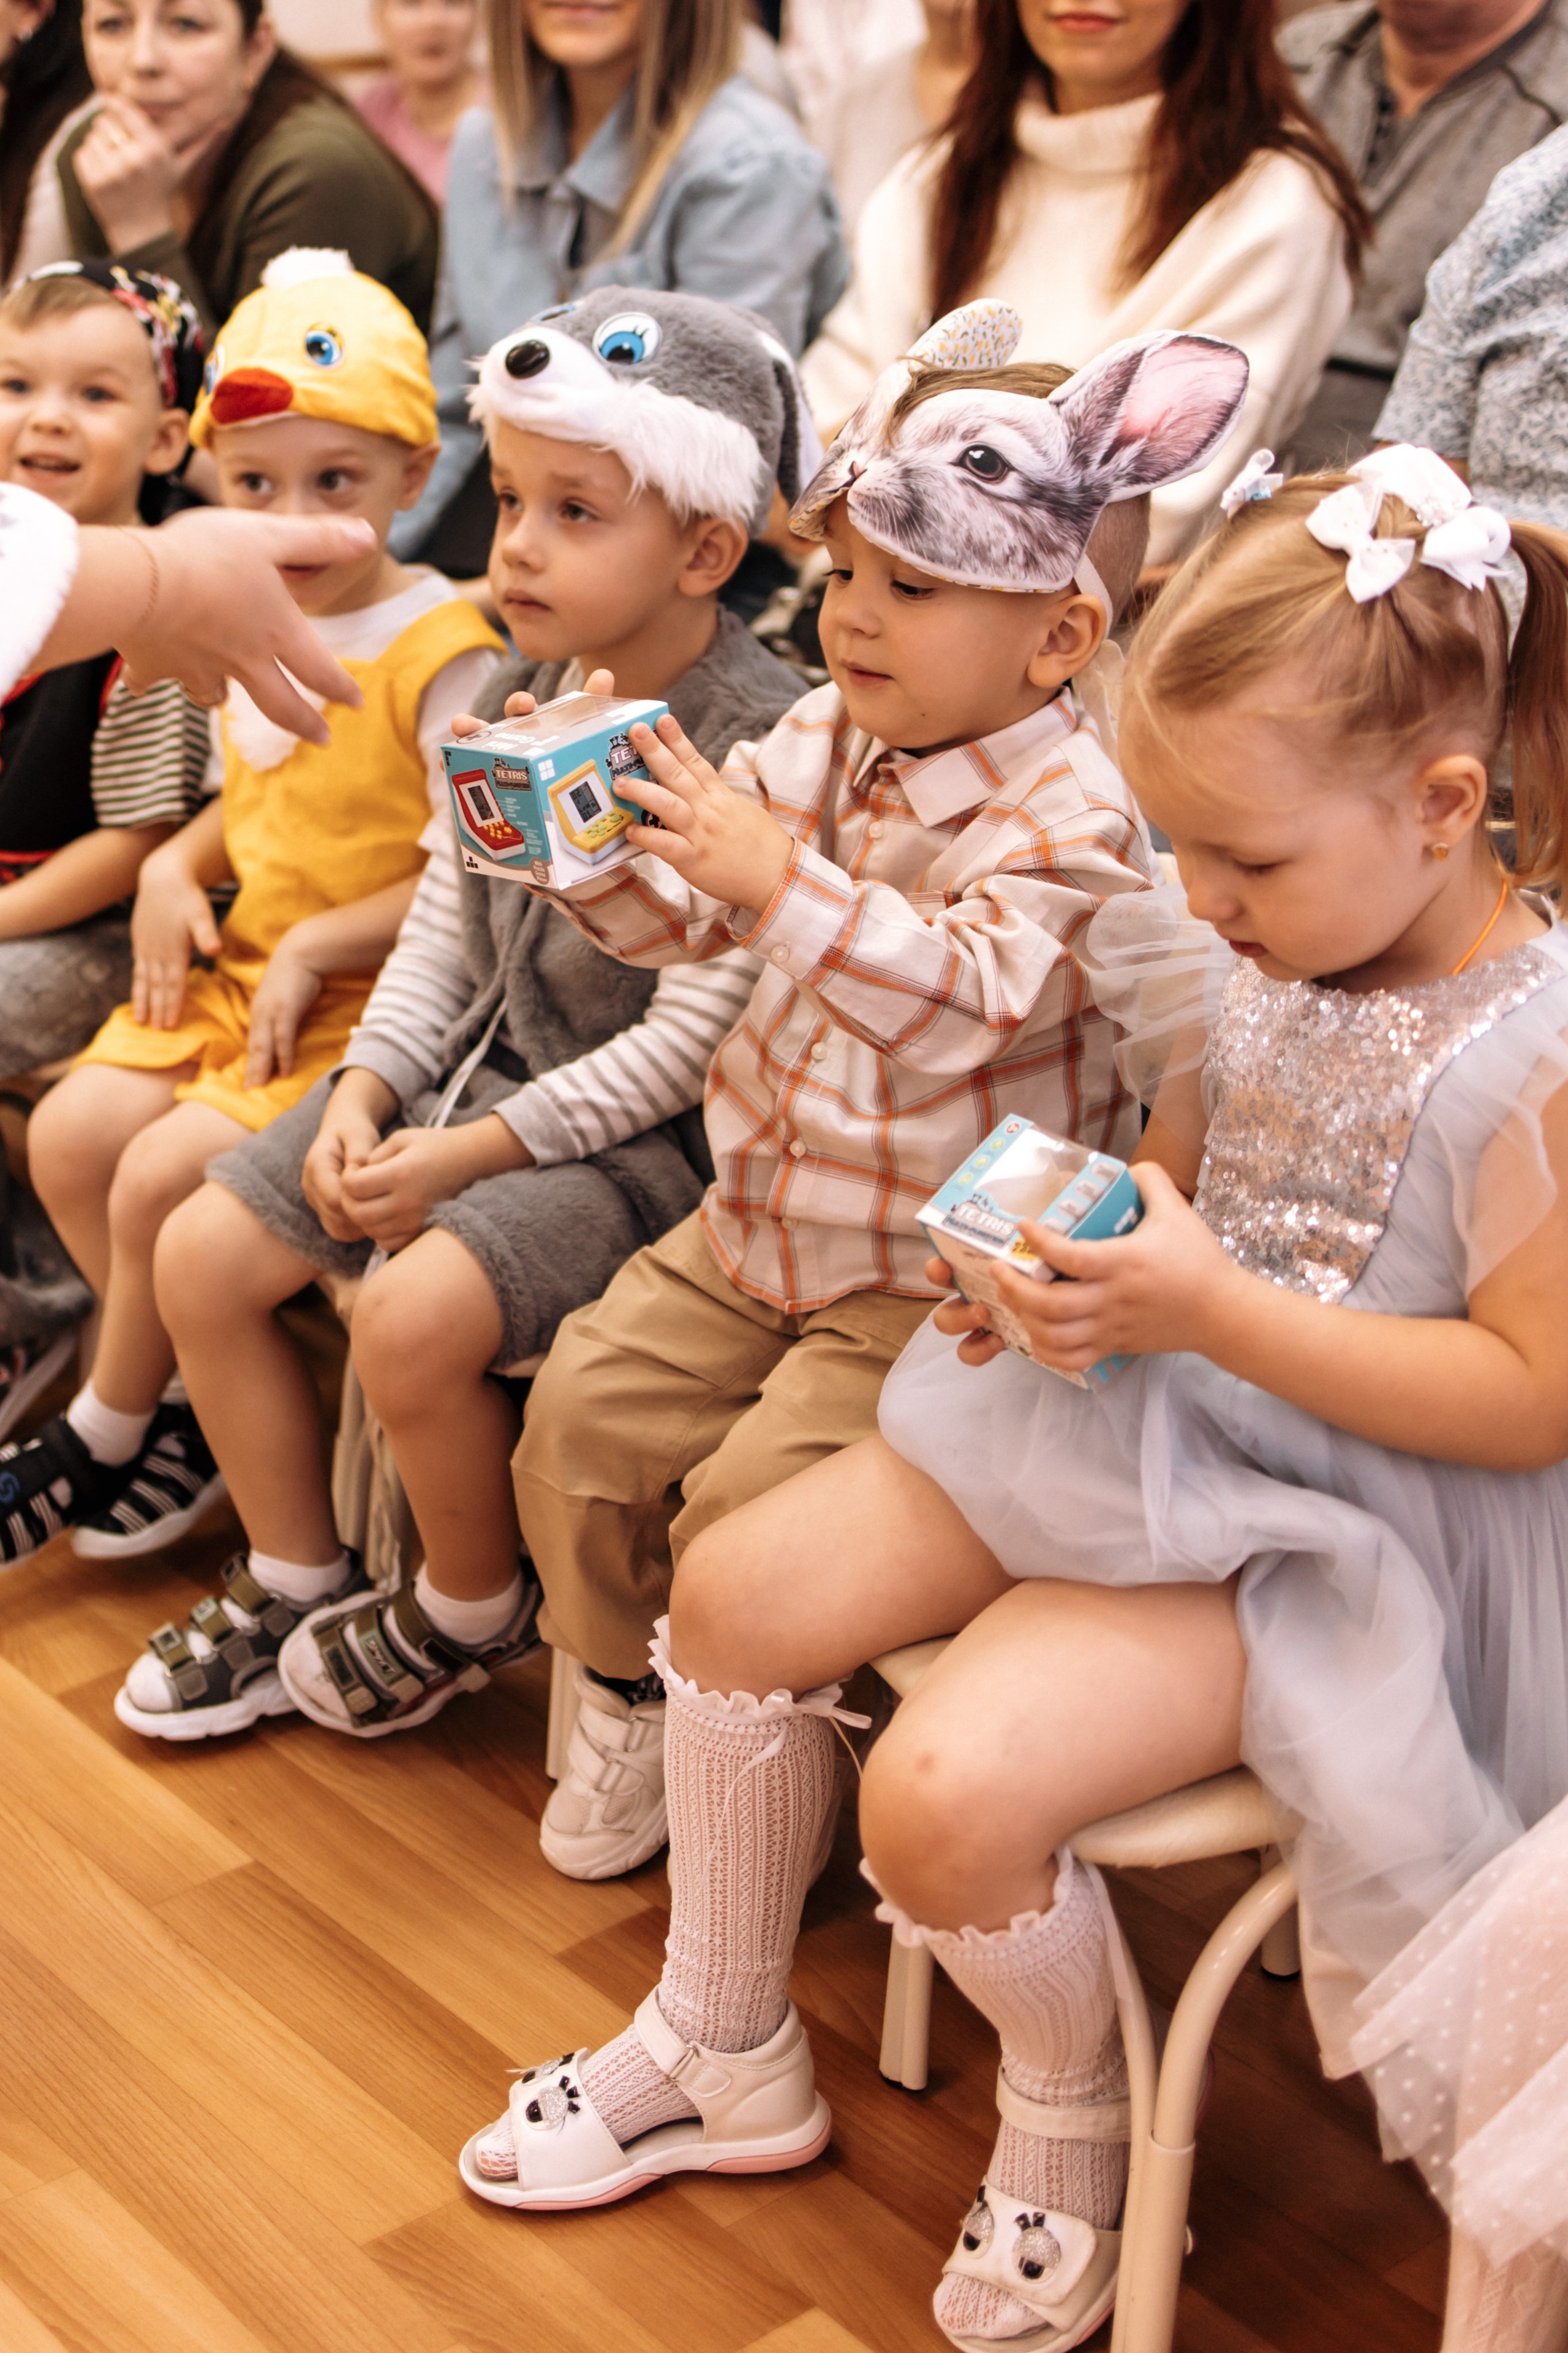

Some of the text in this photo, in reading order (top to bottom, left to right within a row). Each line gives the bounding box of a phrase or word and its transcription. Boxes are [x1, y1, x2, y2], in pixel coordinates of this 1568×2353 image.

[611, 746, 638, 765] TET
[496, 769, 528, 780] TETRIS
[958, 1204, 1015, 1235] TETRIS
